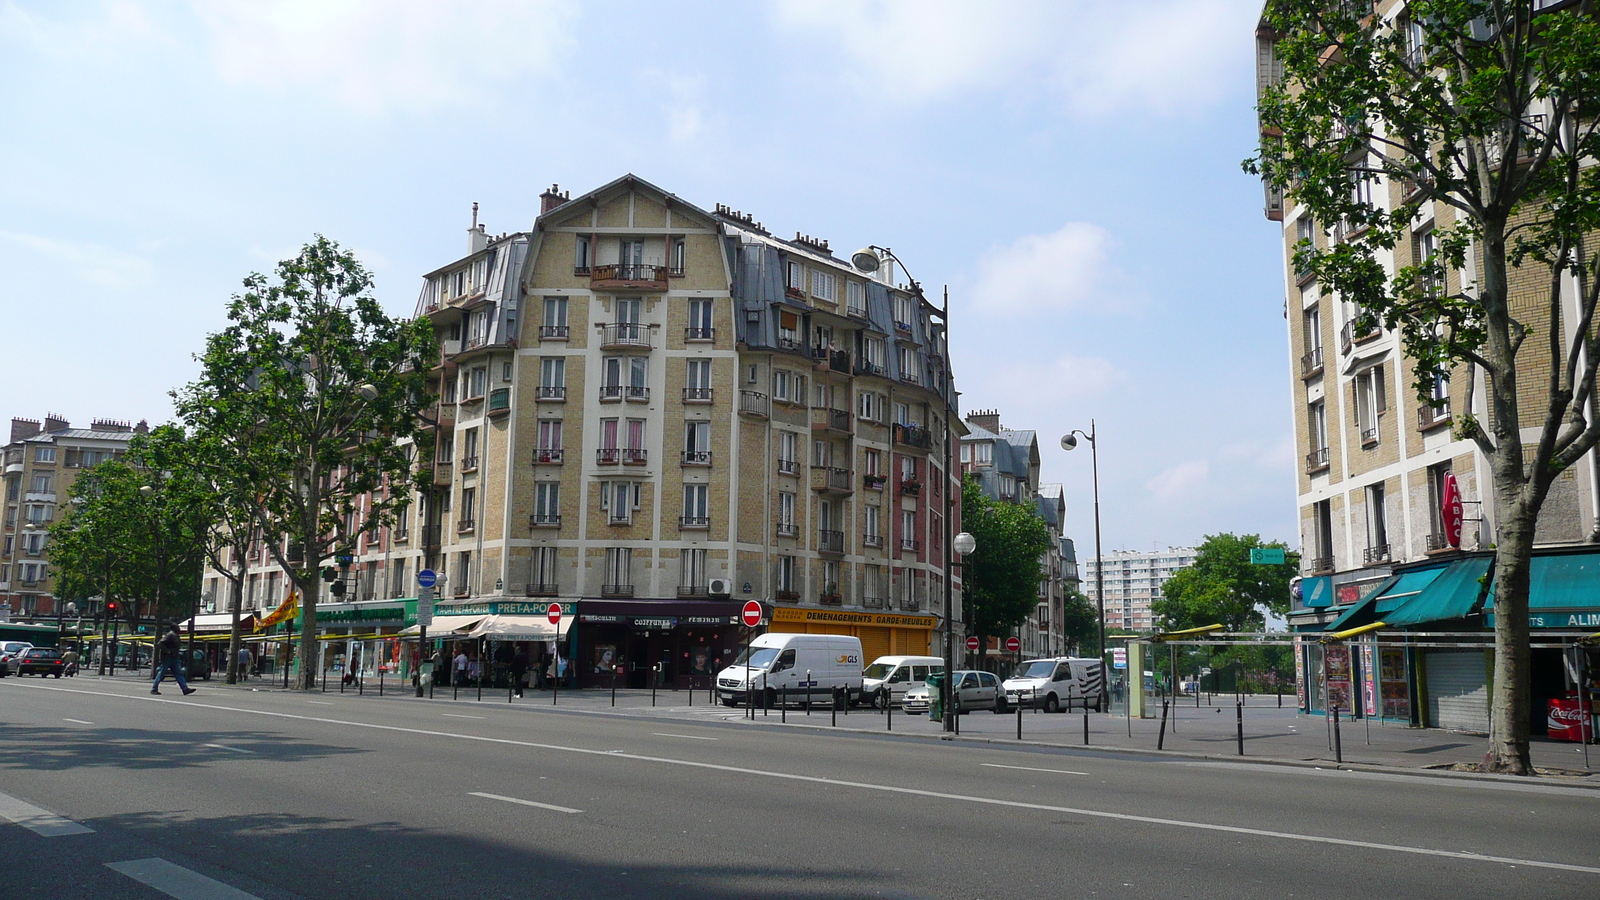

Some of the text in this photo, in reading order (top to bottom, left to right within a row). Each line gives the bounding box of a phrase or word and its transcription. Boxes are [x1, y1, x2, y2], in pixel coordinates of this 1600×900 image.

[1451, 484, 1461, 538] TABAC
[497, 603, 571, 613] PRET-A-POER
[806, 611, 872, 623] DEMENAGEMENTS
[876, 616, 932, 626] GARDE-MEUBLES
[847, 655, 858, 664] GLS
